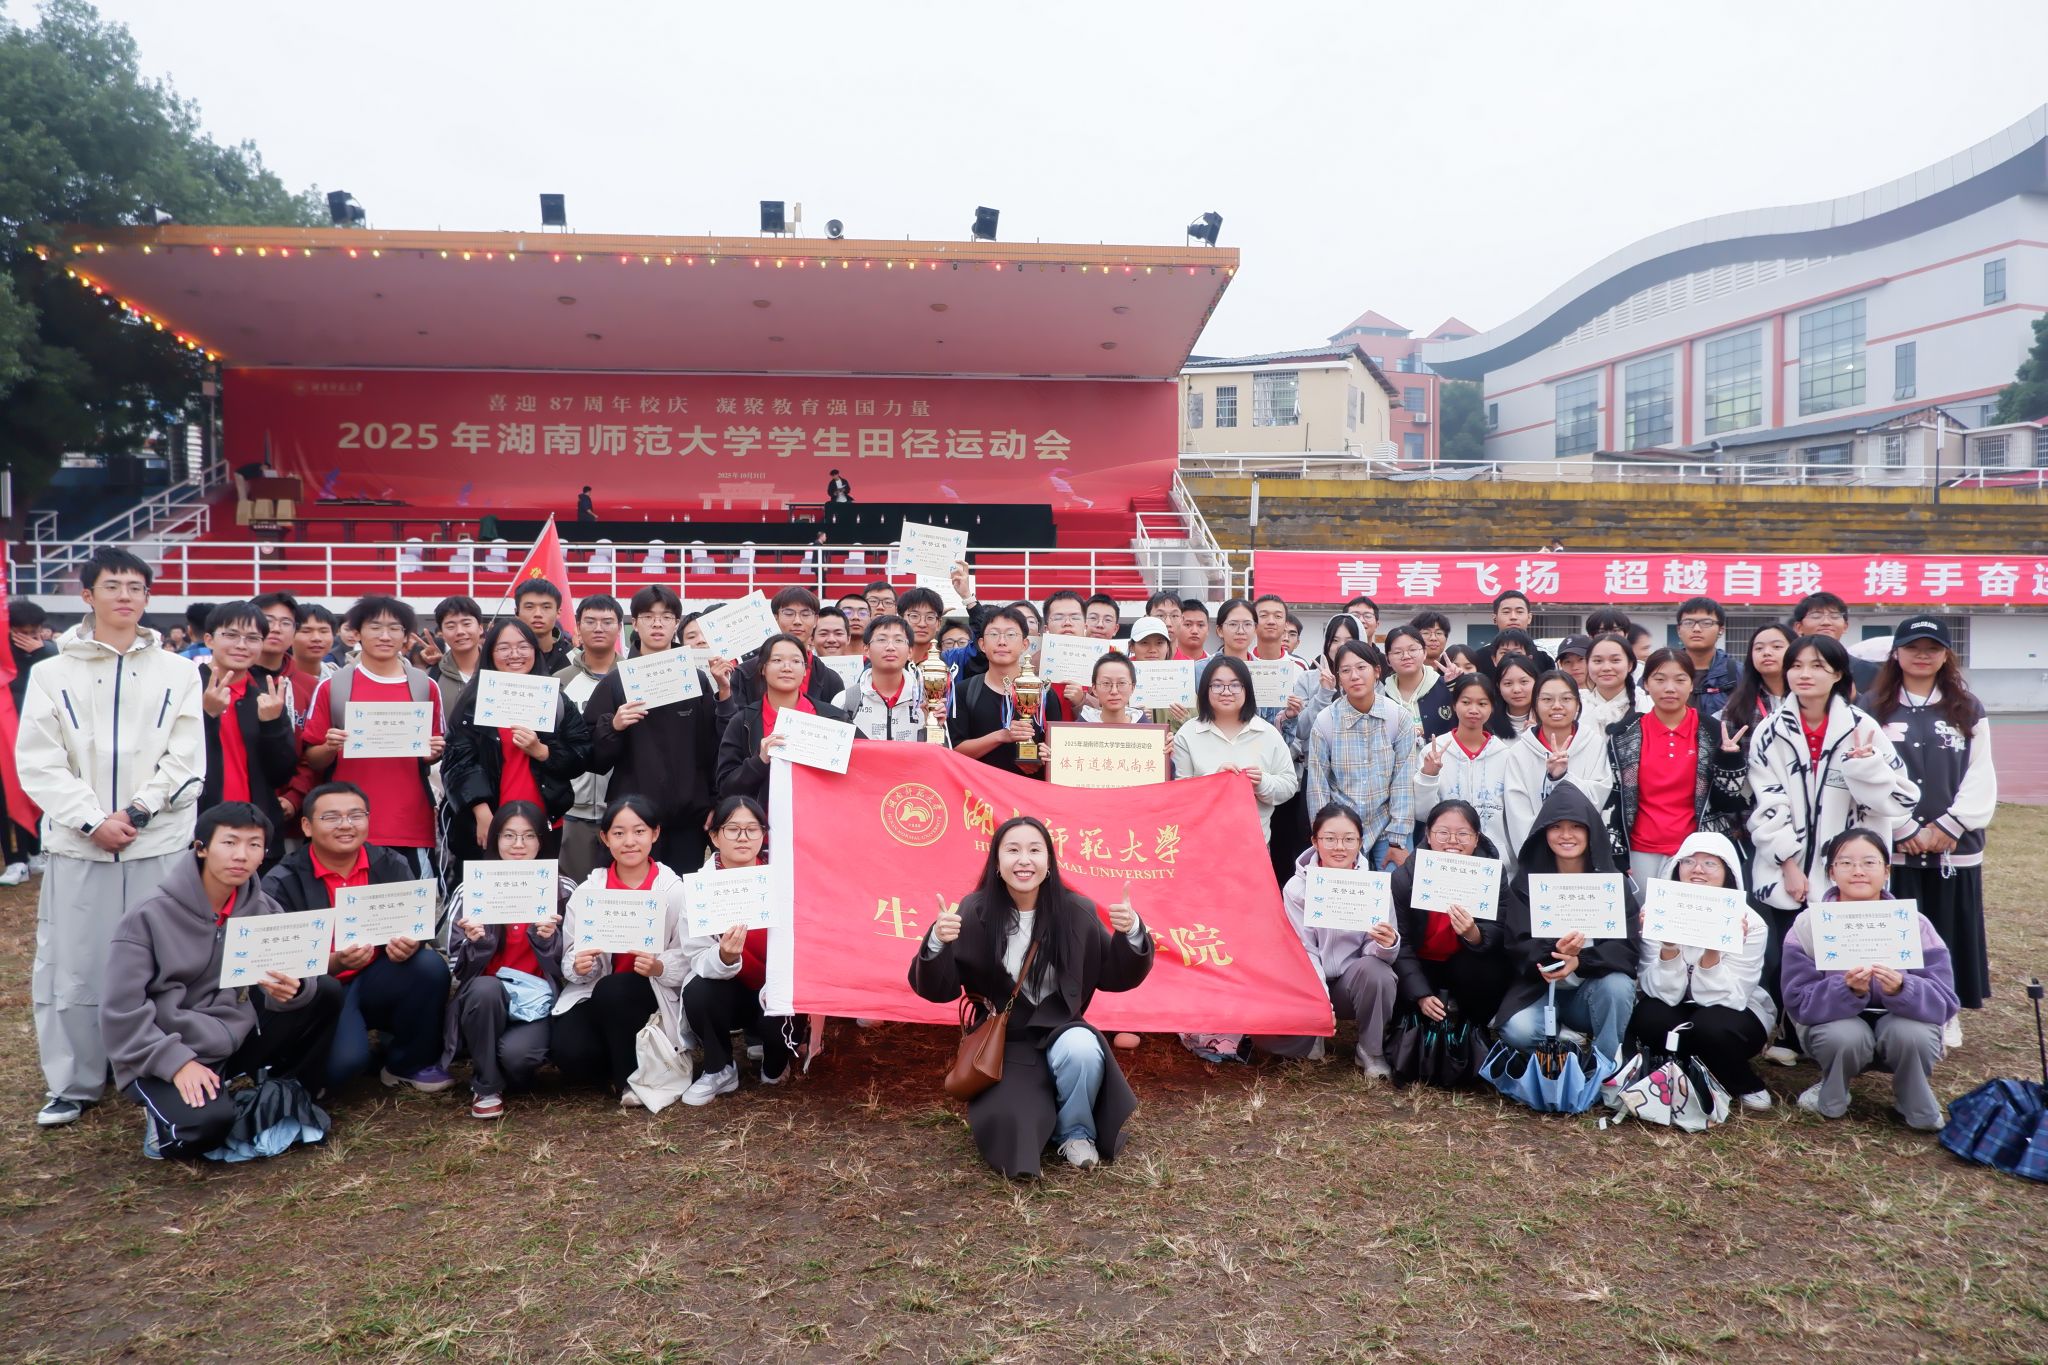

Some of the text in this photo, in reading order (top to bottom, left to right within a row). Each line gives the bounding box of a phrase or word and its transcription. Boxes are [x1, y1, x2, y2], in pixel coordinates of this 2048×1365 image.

[488, 394, 932, 417] 喜迎87周年校庆 凝聚教育强国力量
[338, 421, 1072, 462] 2025年湖南师范大学学生田径运动会
[1336, 560, 1560, 598] 青春飞扬
[1604, 560, 1822, 597] 超越自我
[1060, 756, 1157, 773] 体育道德风尚奖
[1056, 859, 1175, 880] MAL UNIVERSITY
